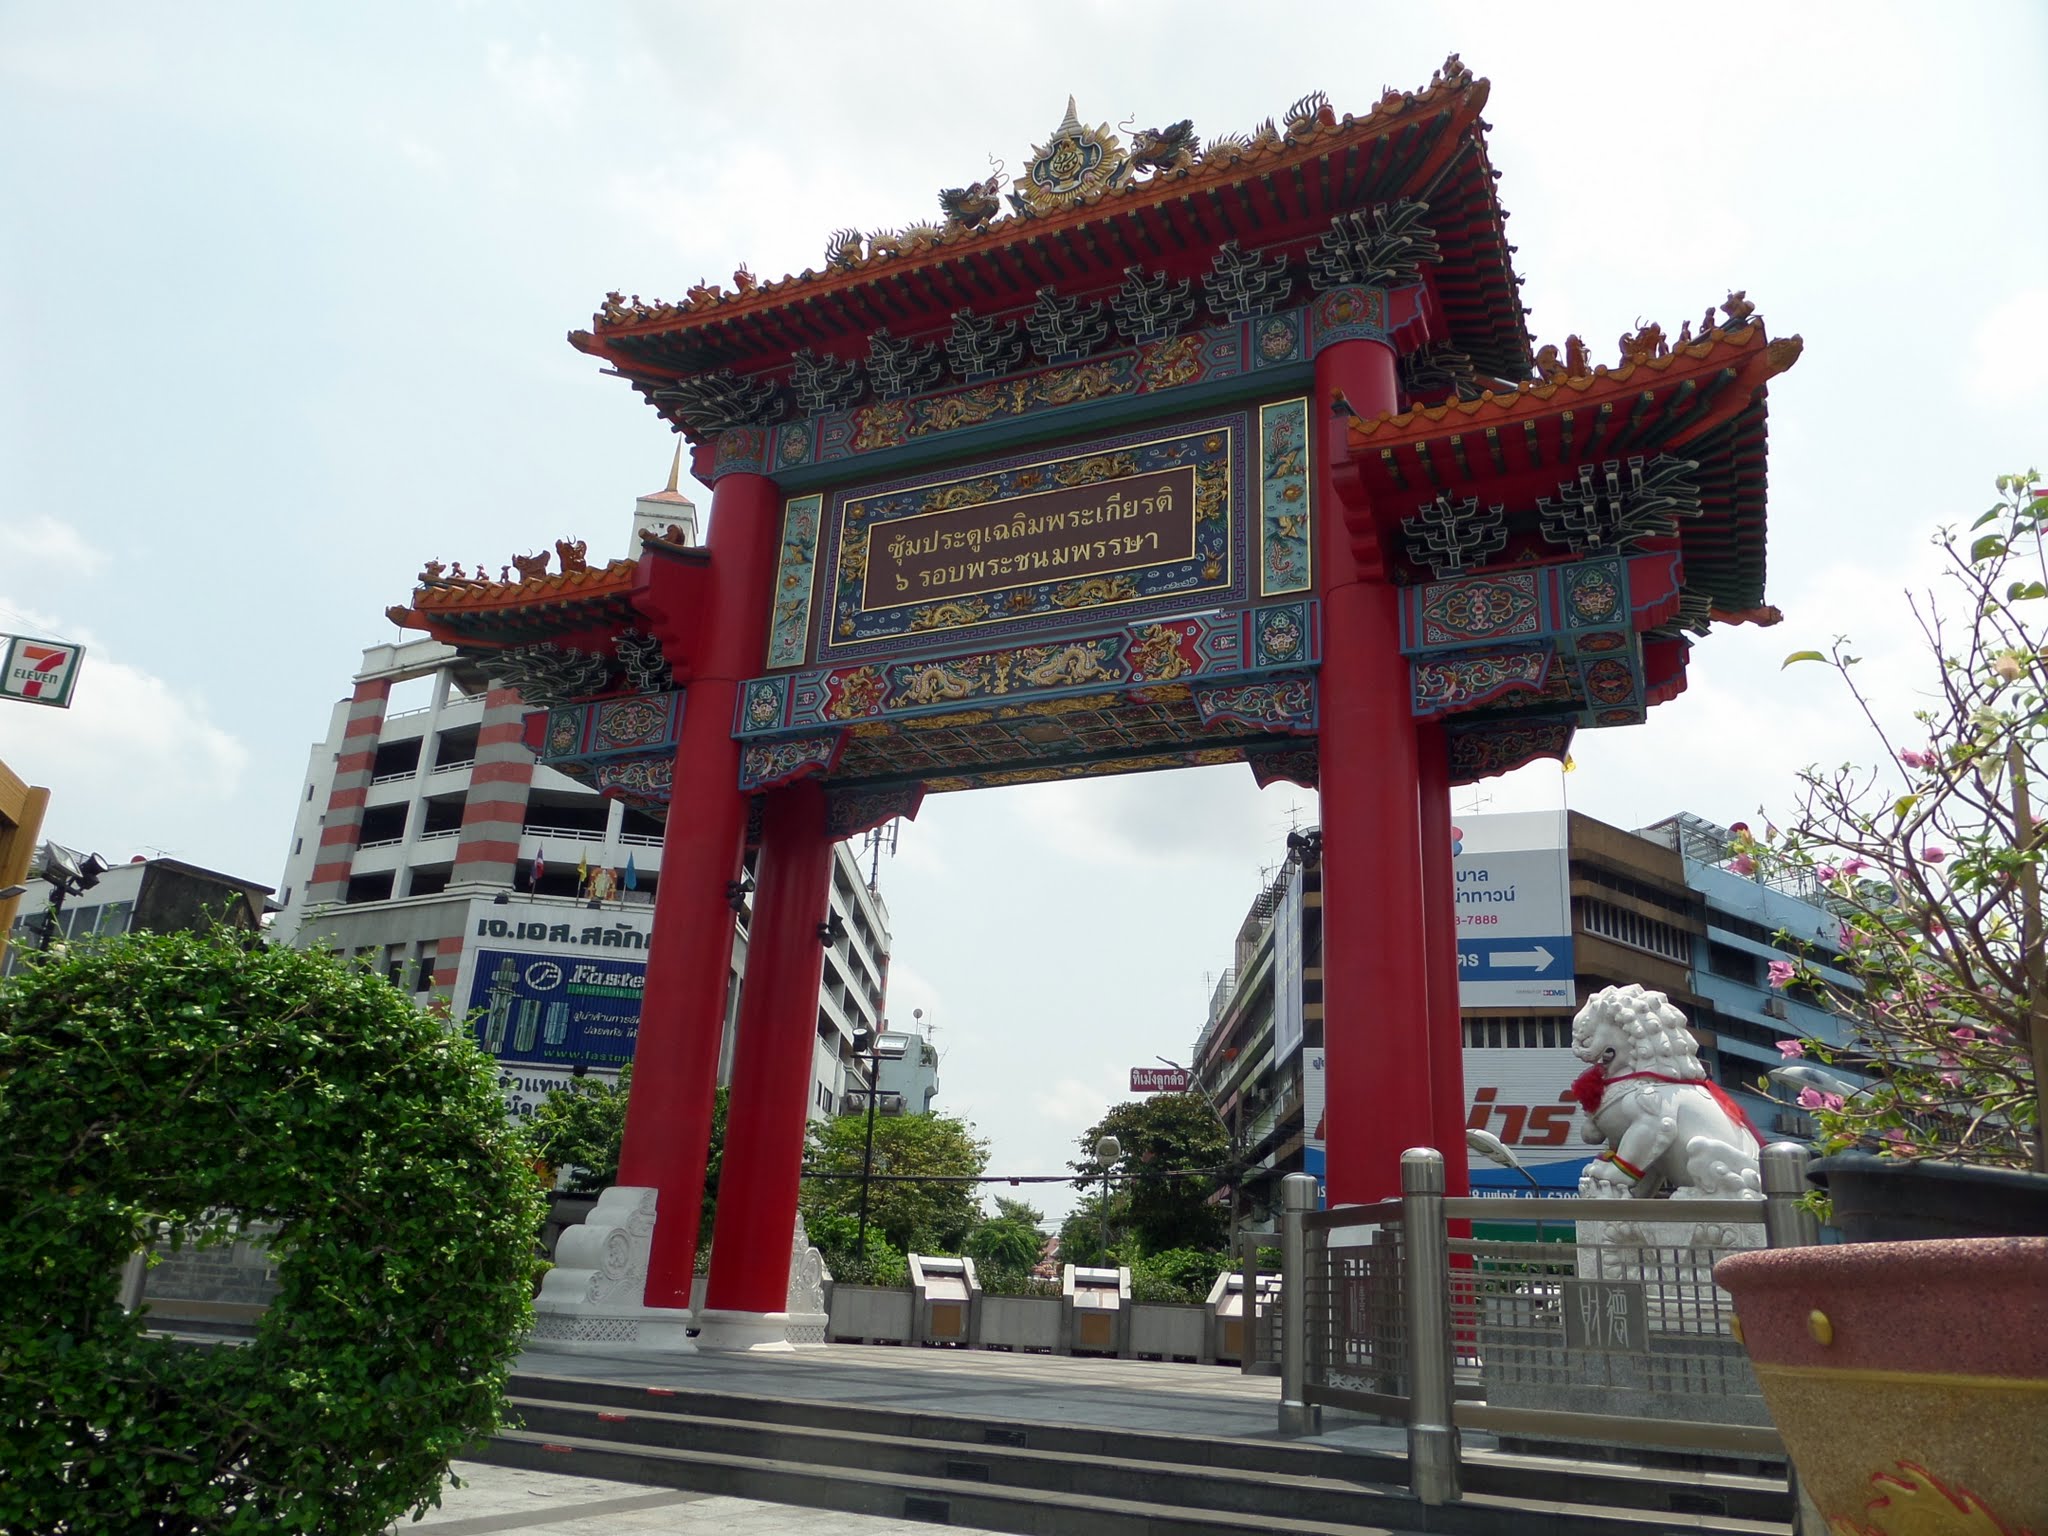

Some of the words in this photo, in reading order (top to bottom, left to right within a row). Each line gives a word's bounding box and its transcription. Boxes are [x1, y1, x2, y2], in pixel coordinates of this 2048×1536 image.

[887, 485, 1173, 566] ซุ้มประตูเฉลิมพระเกียรติ
[919, 531, 1160, 587] รอบพระชนมพรรษา
[22, 645, 67, 697] 7
